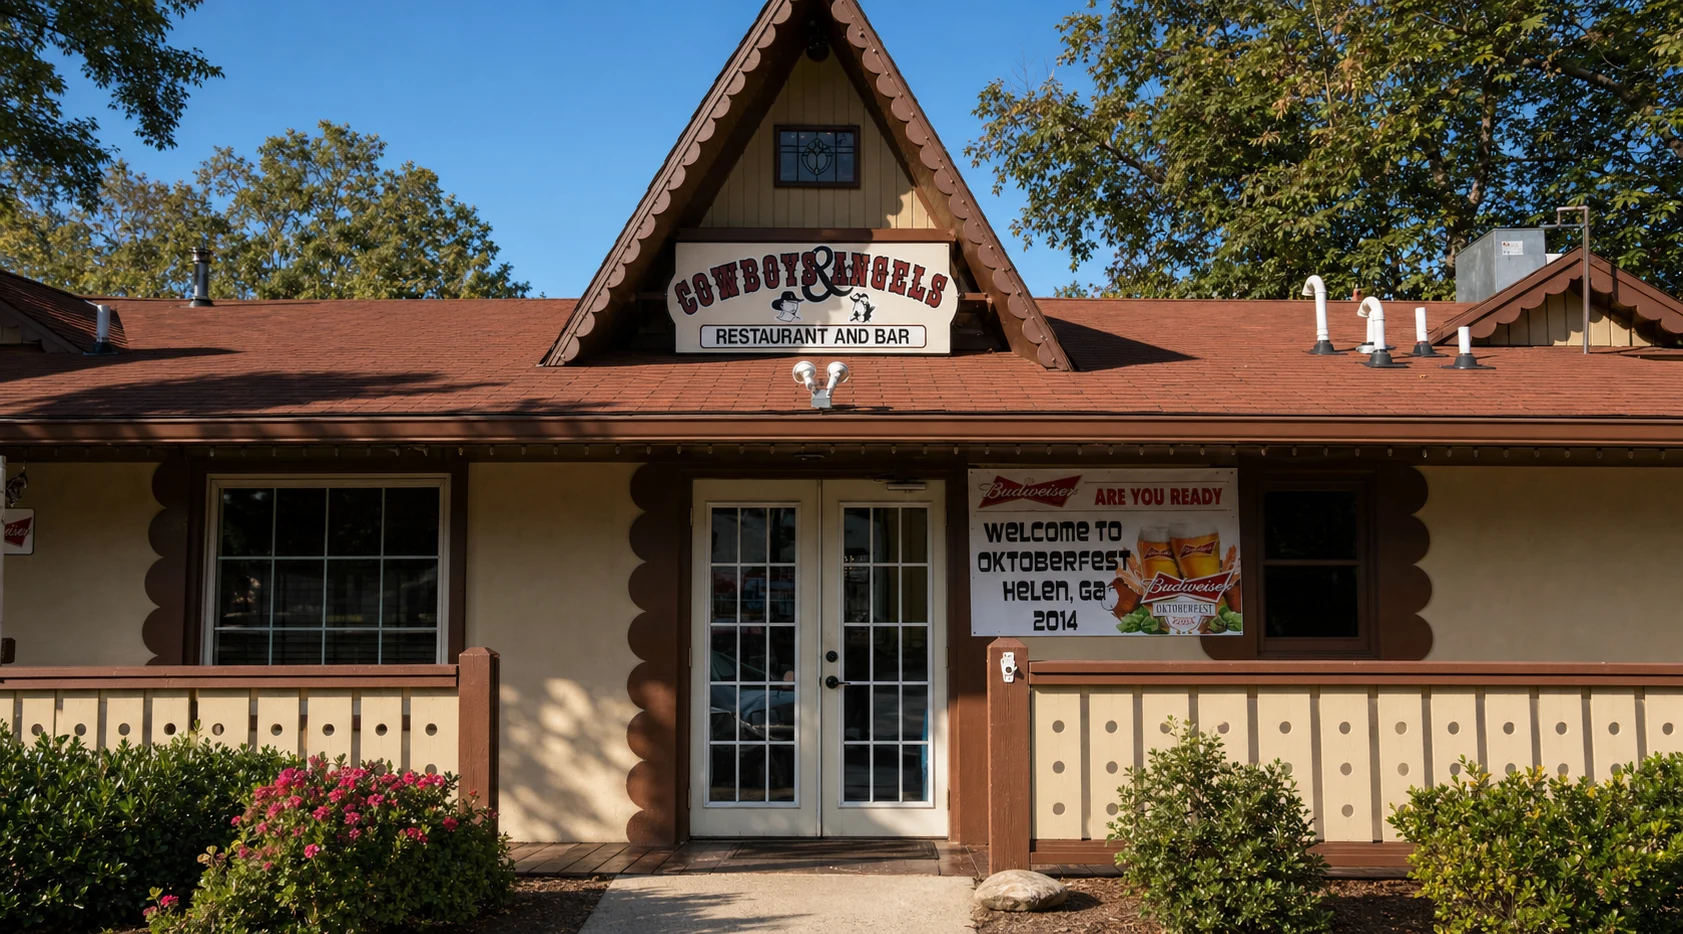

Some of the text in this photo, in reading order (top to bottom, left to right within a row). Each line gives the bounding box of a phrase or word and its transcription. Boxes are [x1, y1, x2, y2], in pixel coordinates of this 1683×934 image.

[674, 245, 948, 315] COWBOYS & ANGELS
[715, 328, 909, 345] RESTAURANT AND BAR
[979, 481, 1079, 499] Budweiser
[1094, 487, 1223, 505] ARE YOU READY
[1095, 520, 1122, 542] TO
[1142, 577, 1233, 595] Budweiser
[1156, 604, 1213, 614] OKTOBERFEST
[1032, 610, 1078, 631] 2014
